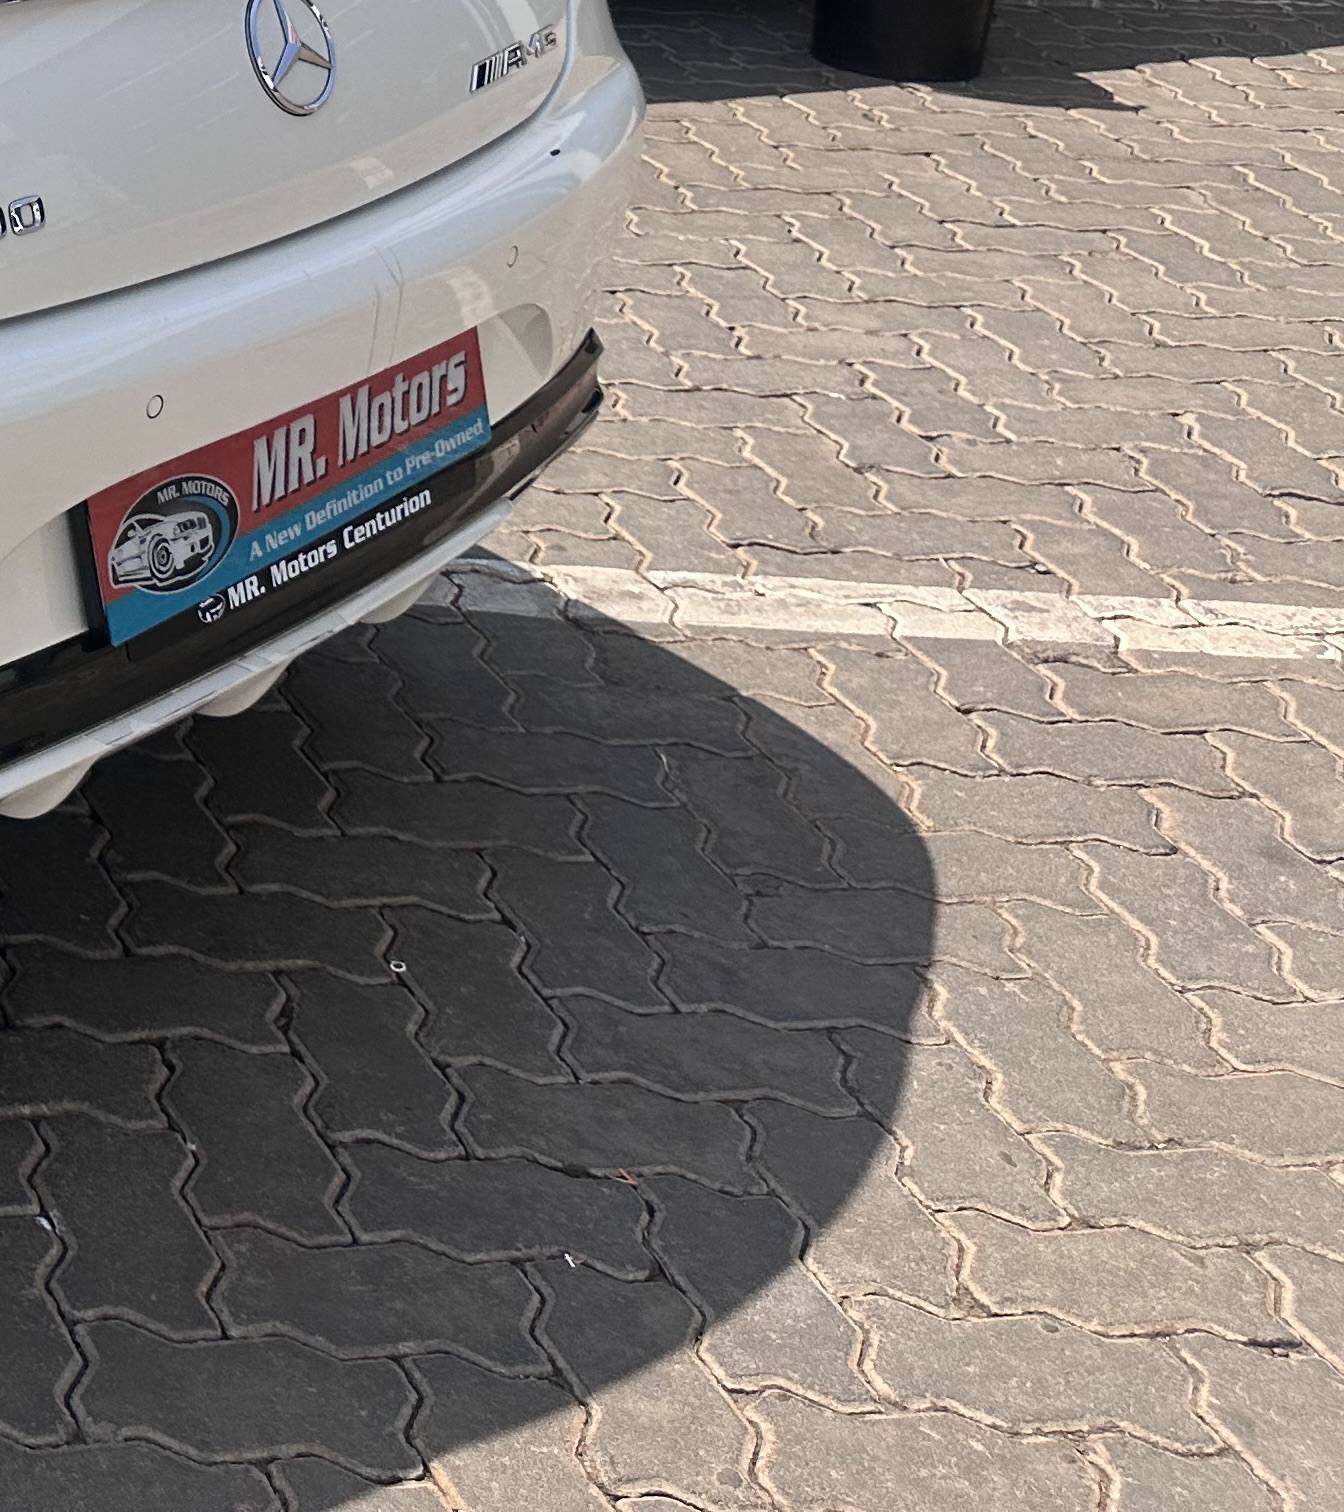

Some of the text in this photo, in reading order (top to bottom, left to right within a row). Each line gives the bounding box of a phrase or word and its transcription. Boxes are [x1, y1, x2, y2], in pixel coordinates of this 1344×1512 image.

[181, 479, 231, 507] MOTORS
[248, 418, 485, 562] A New Definition to Pre-Owned
[252, 350, 467, 513] MR. Motors
[227, 489, 432, 610] MR. Motors Centurion
